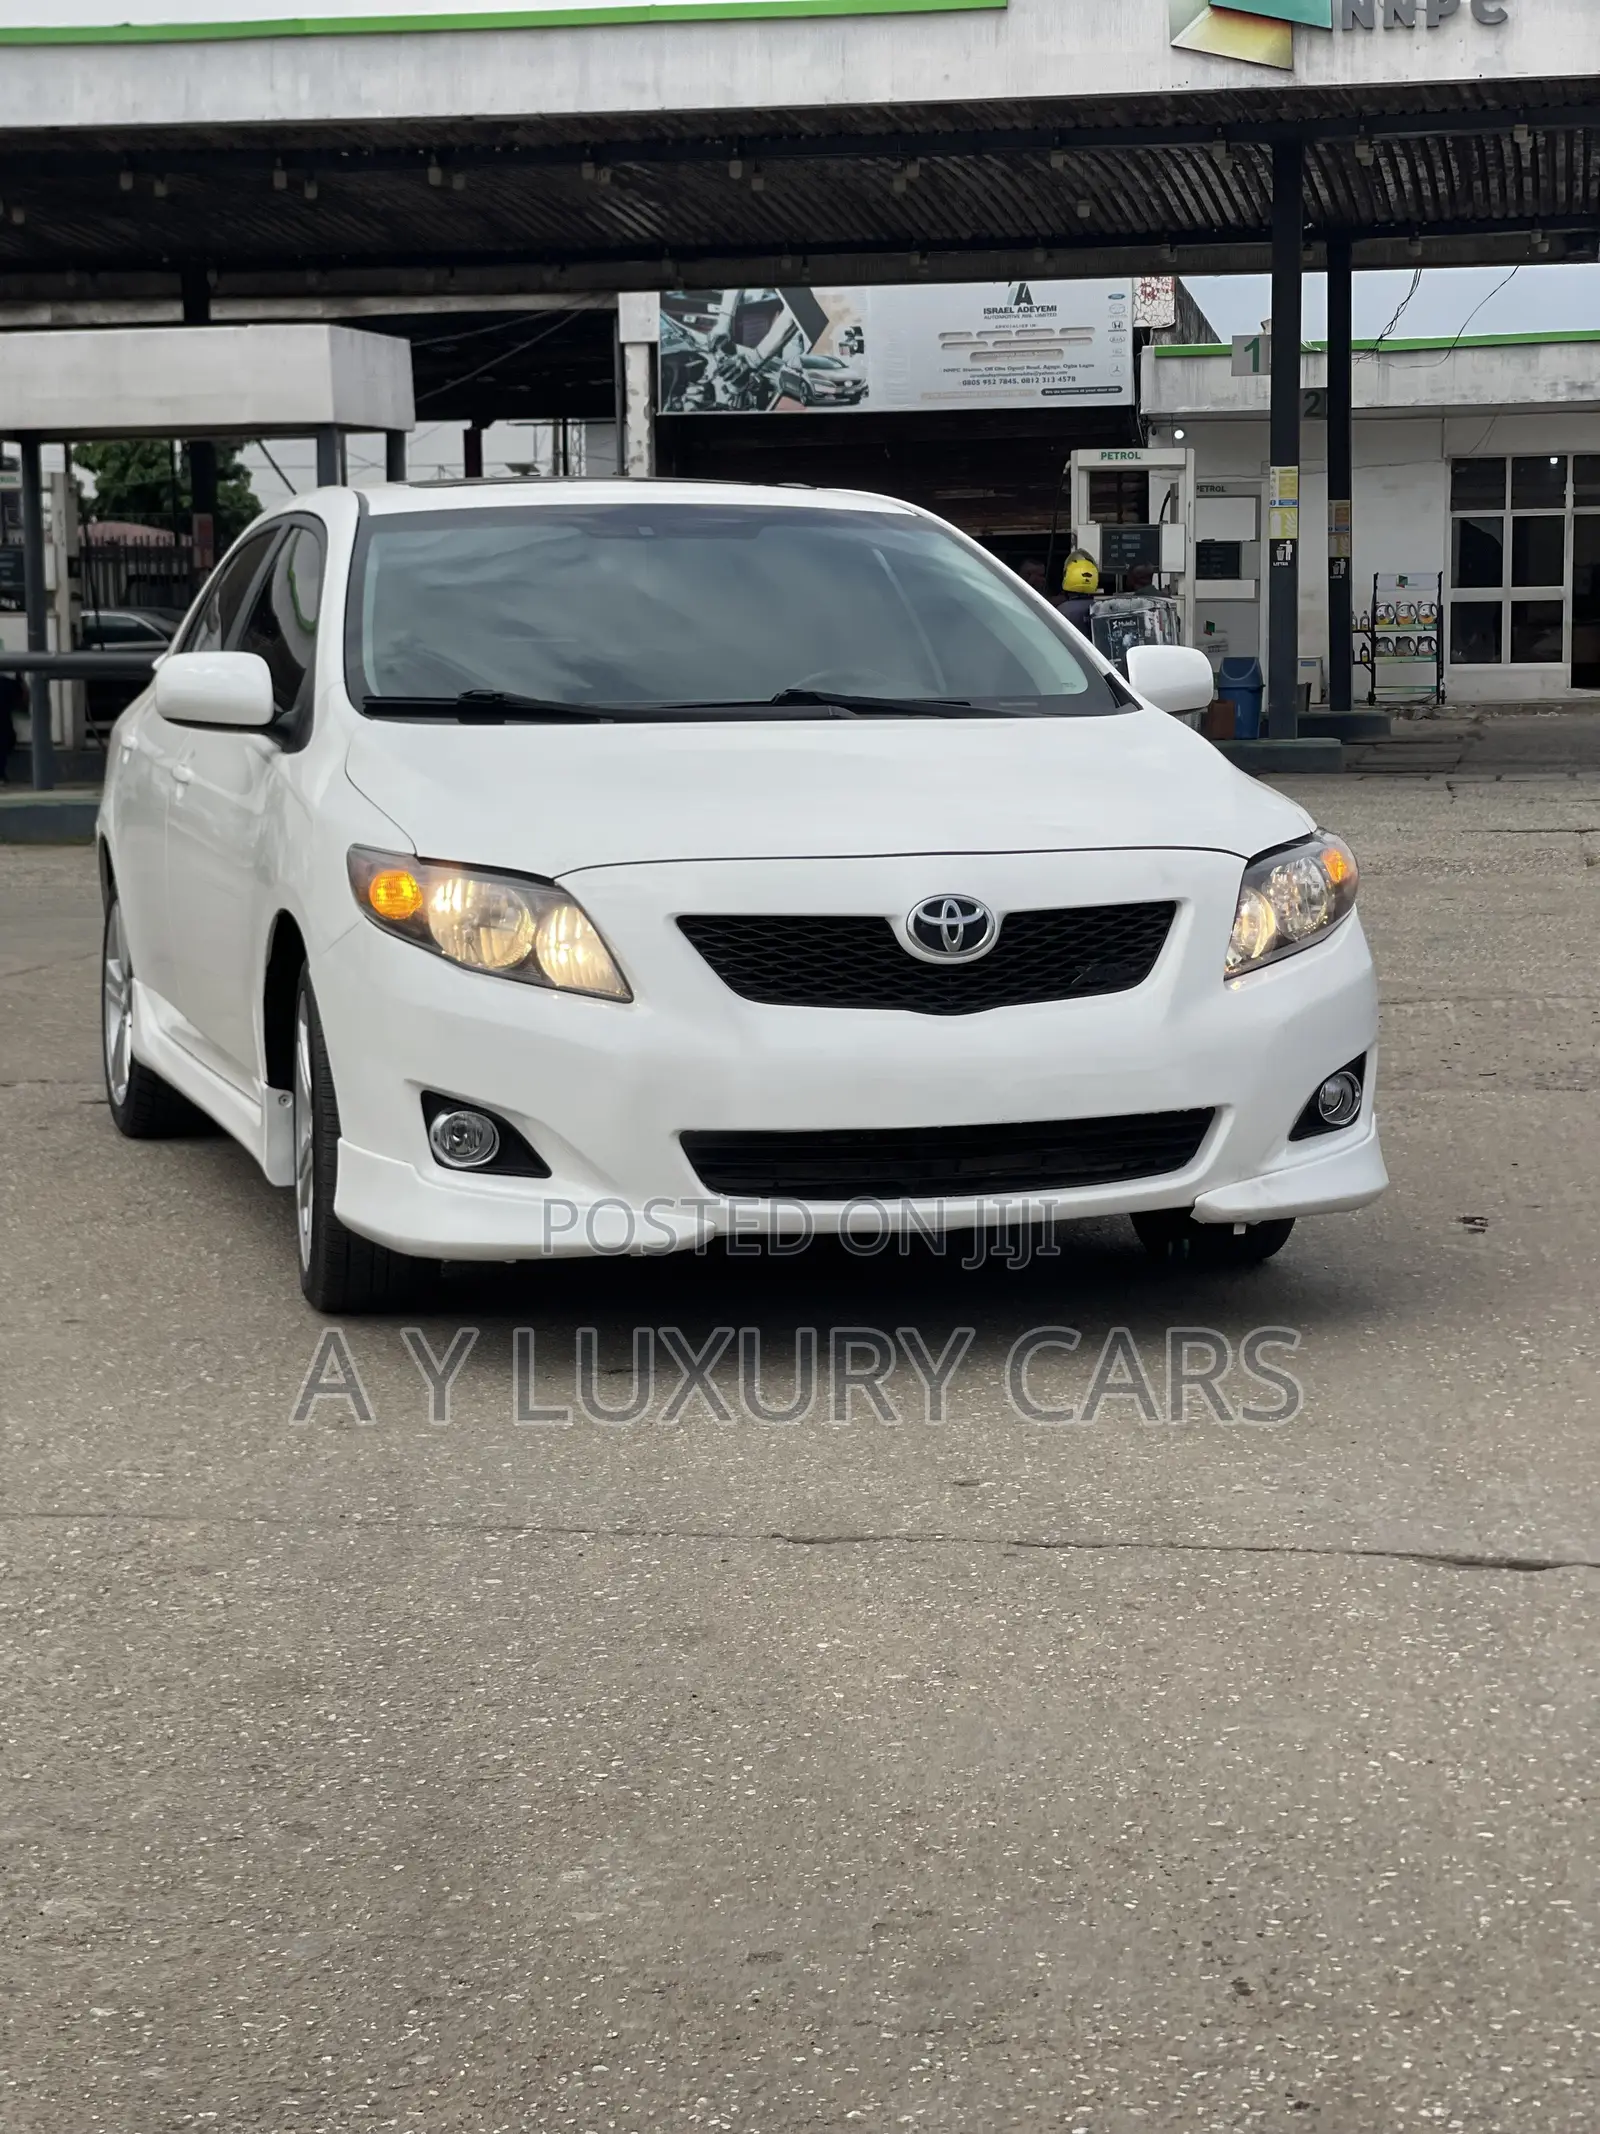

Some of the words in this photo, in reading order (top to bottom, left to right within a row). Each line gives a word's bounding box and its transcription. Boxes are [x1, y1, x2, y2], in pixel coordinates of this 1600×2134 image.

[1341, 0, 1508, 30] NNPC
[983, 306, 1015, 315] ISRAEL
[1017, 305, 1058, 313] ADEYEMI
[1243, 337, 1260, 373] 1
[1057, 375, 1077, 383] 4578
[1303, 390, 1322, 418] 2
[1100, 451, 1142, 461] PETROL
